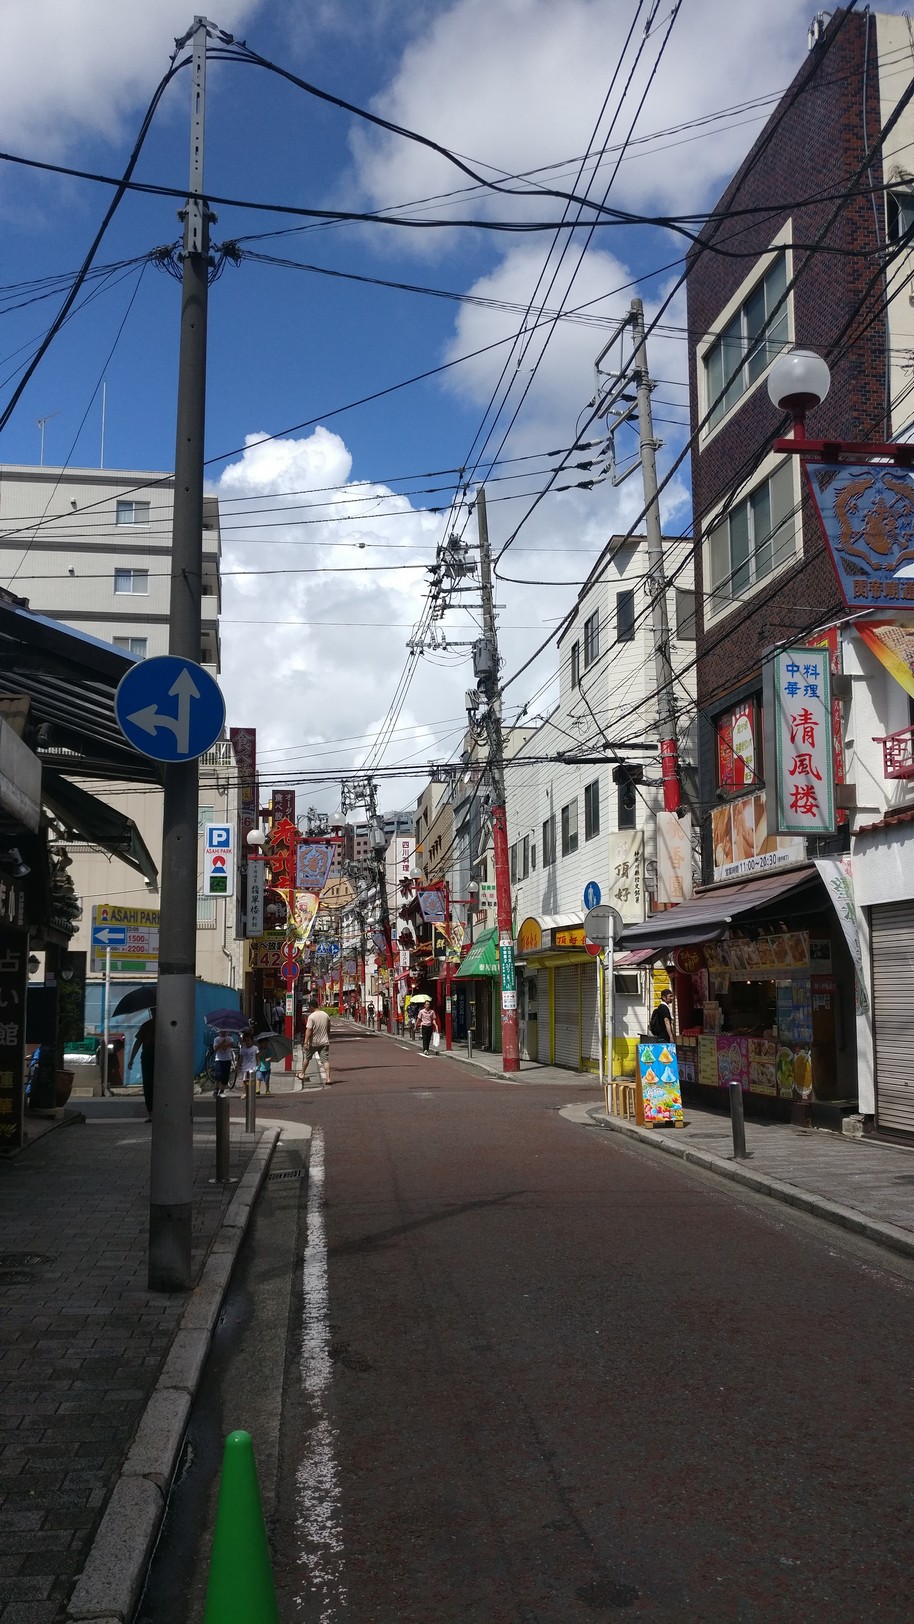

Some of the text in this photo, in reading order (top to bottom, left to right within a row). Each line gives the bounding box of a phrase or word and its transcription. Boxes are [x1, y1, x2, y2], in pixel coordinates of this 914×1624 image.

[212, 830, 227, 846] P
[402, 841, 410, 872] 四川料理
[111, 909, 138, 922] ASAHI
